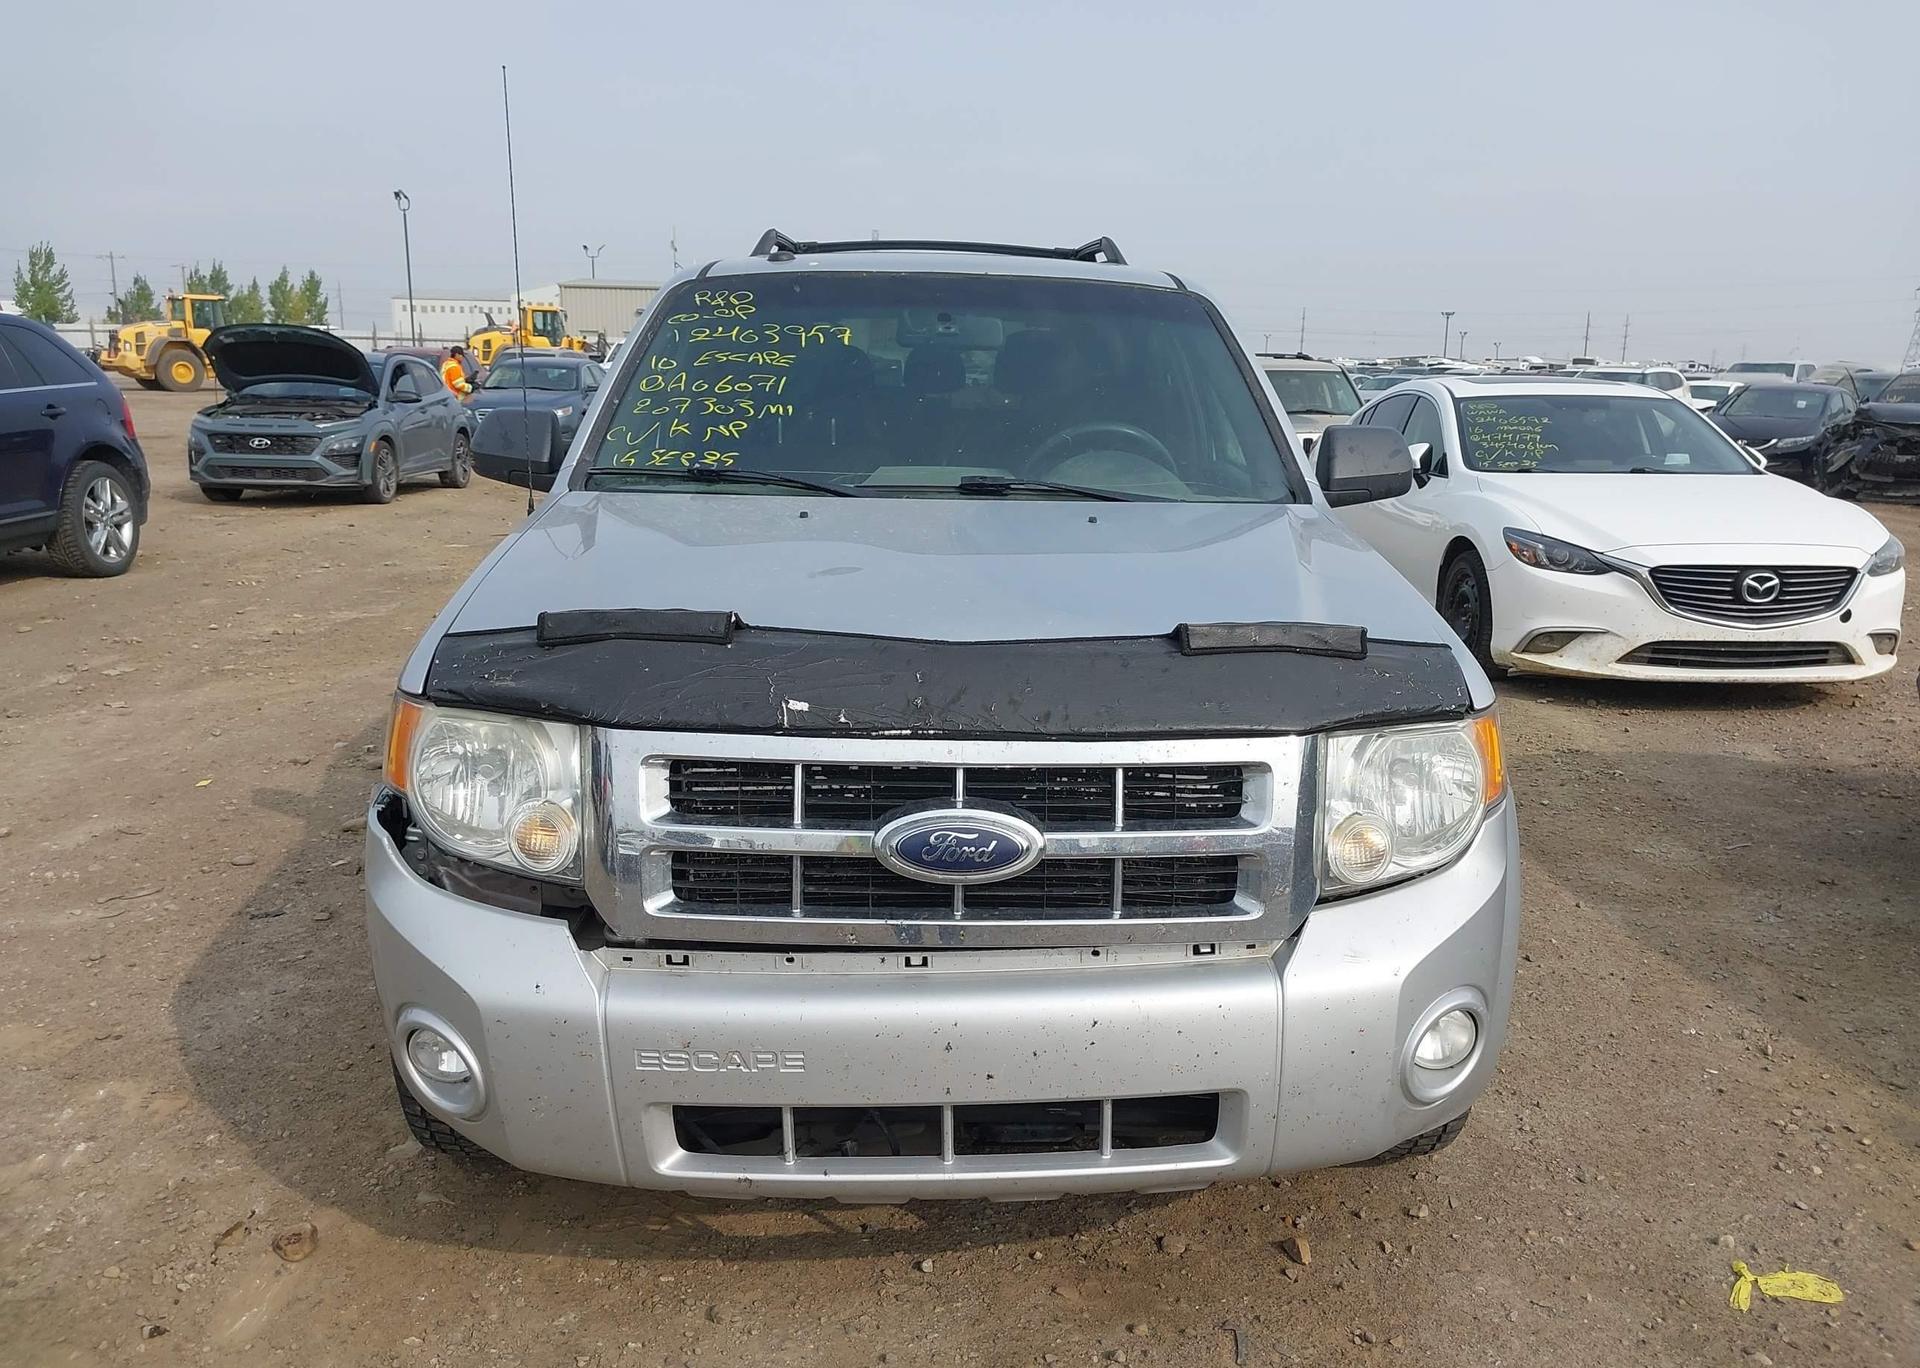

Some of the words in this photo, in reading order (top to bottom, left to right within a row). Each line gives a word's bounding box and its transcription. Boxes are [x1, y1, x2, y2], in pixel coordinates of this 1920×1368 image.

[651, 355, 677, 369] 10
[693, 351, 797, 367] ESCAPE
[633, 398, 754, 417] 207303
[921, 830, 998, 863] Ford
[633, 1048, 806, 1073] ESCAPE
